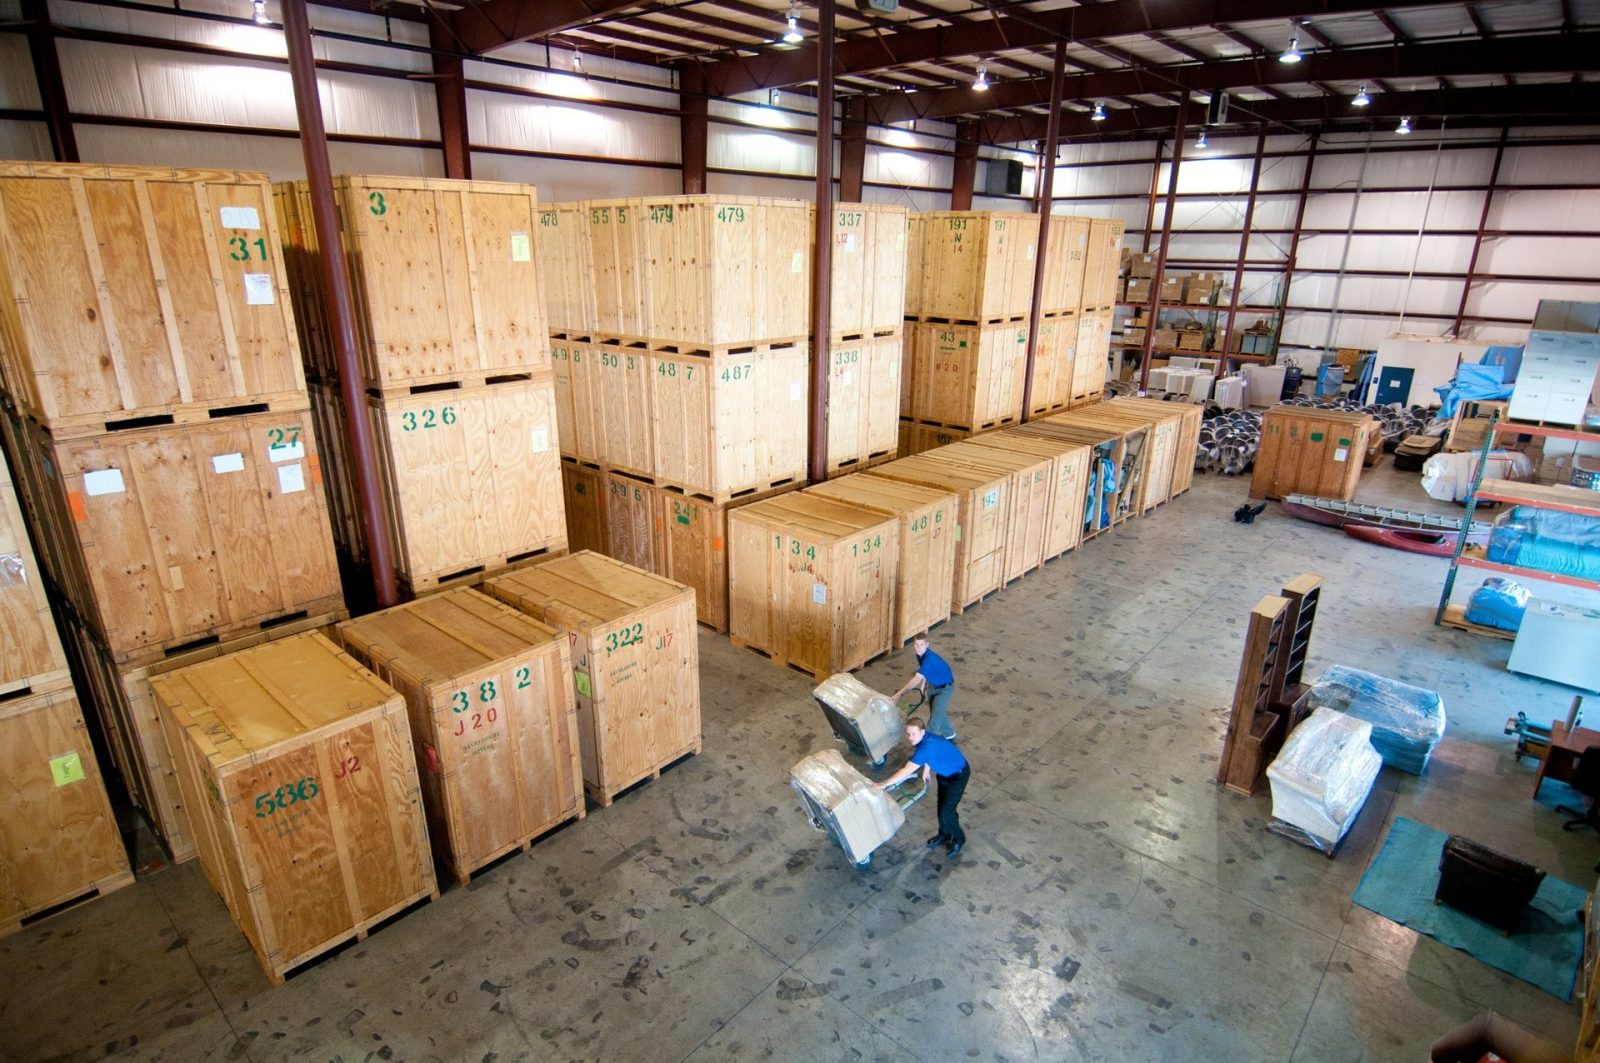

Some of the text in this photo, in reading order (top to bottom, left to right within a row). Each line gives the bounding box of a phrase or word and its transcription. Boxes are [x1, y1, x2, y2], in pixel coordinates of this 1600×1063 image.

[369, 191, 386, 216] 3
[540, 212, 558, 227] 478
[717, 206, 745, 223] 479
[839, 212, 862, 227] 337
[229, 236, 268, 261] 31
[940, 331, 956, 342] 43
[835, 350, 858, 365] 338
[721, 364, 752, 383] 487
[402, 406, 456, 432] 326
[268, 426, 302, 450] 27
[605, 622, 643, 652] 322
[335, 756, 362, 779] J2
